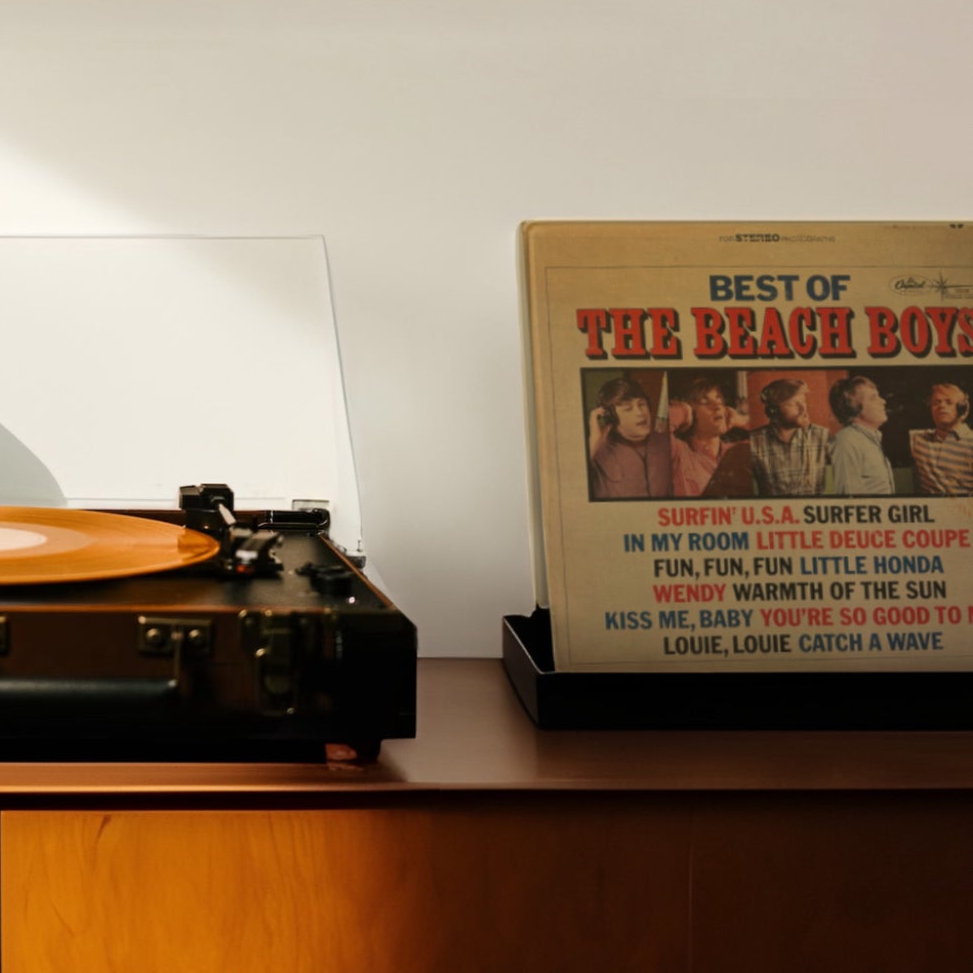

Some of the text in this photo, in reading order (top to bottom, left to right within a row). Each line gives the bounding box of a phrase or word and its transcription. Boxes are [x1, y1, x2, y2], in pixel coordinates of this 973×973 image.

[735, 233, 780, 242] STEREO
[709, 275, 850, 301] BEST OF
[576, 305, 973, 360] THE BEACH BOYS
[658, 505, 935, 527] SURFIN' U.S.A. SURFER GIRL
[624, 529, 971, 552] IN MY ROOM LITTLE DEUCE COUPE
[653, 555, 944, 579] FUN, FUN, FUN LITTLE HONDA
[653, 580, 947, 603] WENDY WARMTH OF THE SUN
[605, 611, 653, 630] KISS
[658, 610, 695, 631] ME,
[699, 609, 754, 628] BABY
[760, 607, 833, 627] YOU'RE
[839, 607, 867, 626] SO
[873, 606, 930, 625] GOOD
[934, 606, 962, 625] TO
[663, 632, 944, 657] LOUIE, LOUIE CATCH A WAVE
